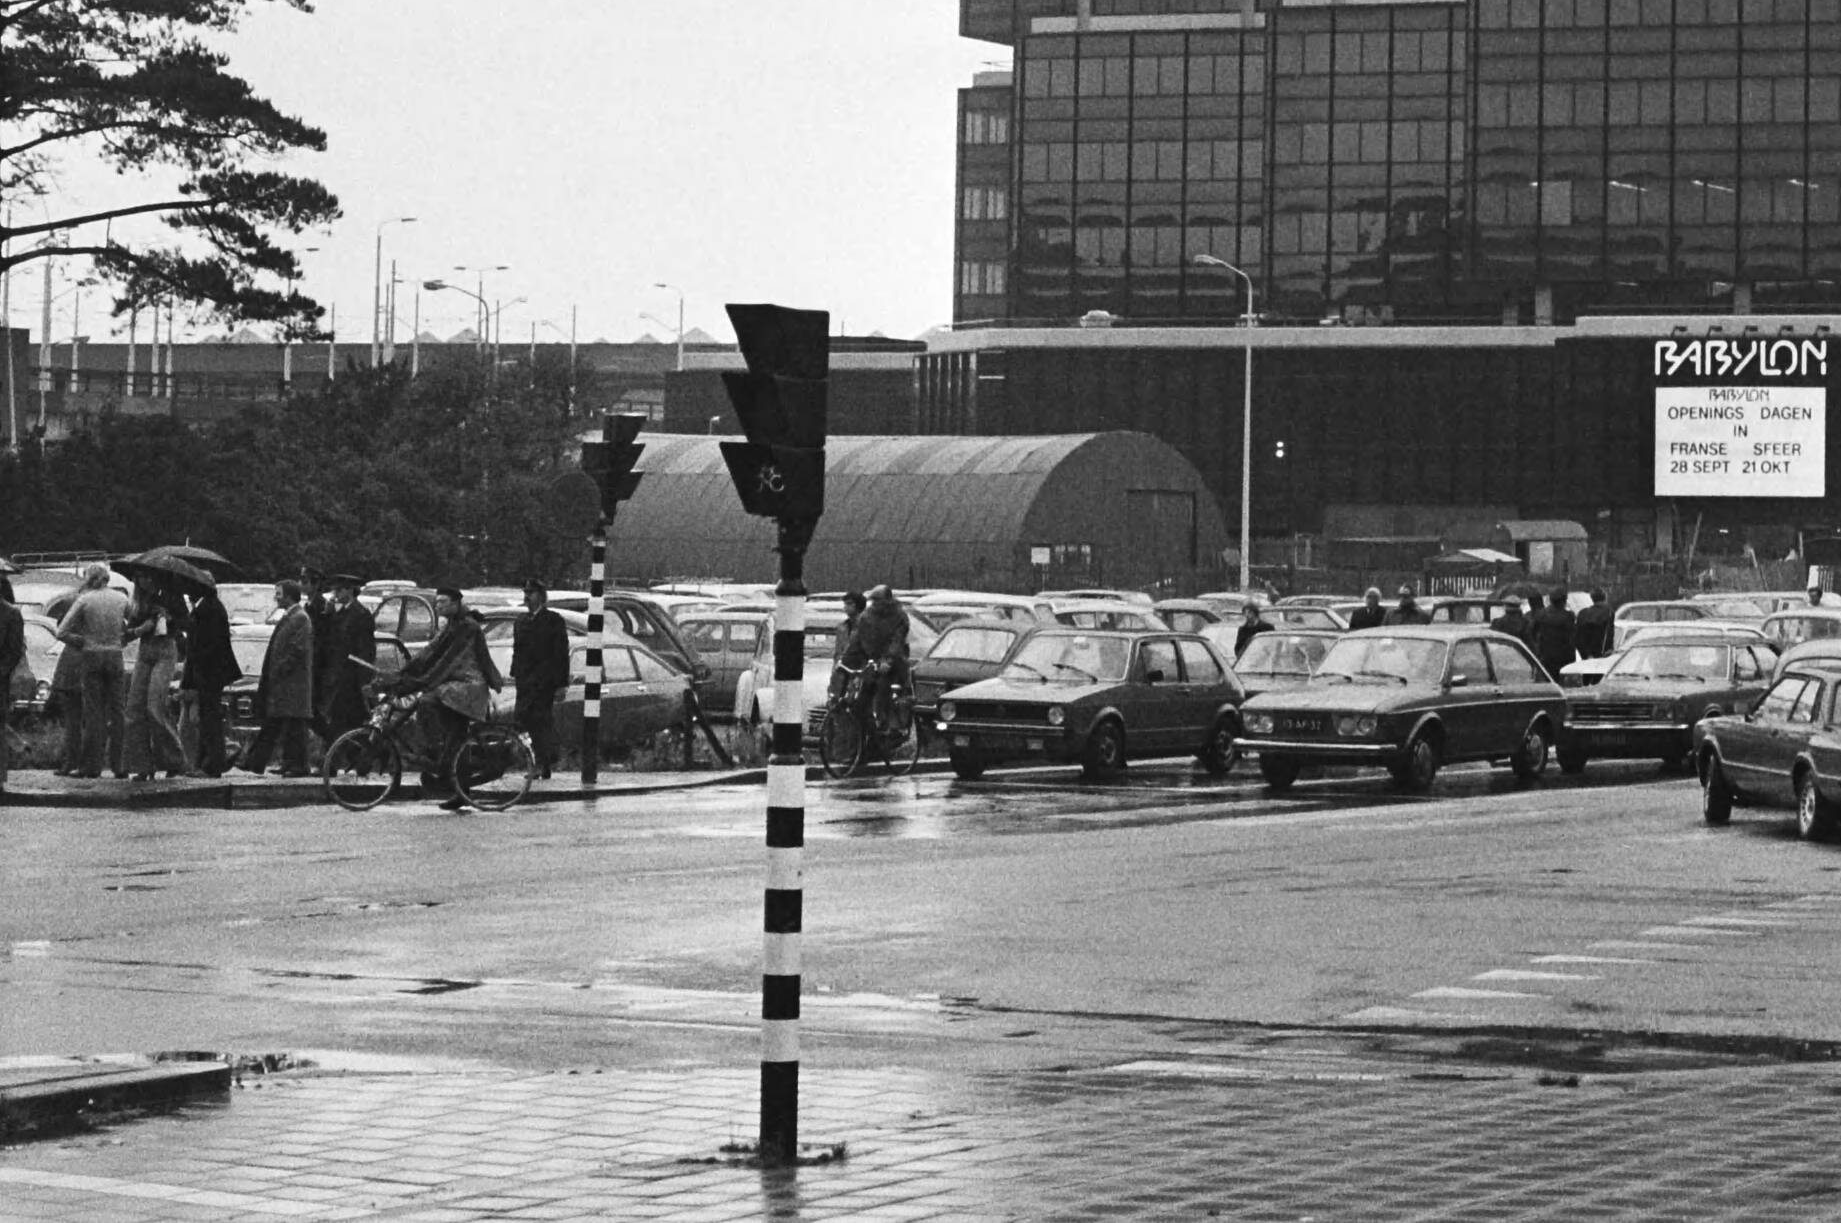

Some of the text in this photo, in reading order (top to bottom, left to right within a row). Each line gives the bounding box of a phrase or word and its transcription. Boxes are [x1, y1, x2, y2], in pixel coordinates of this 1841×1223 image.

[1655, 340, 1827, 376] BABYLON
[1709, 389, 1770, 403] BABYLON
[1667, 407, 1813, 420] OPENINGS DAGEN
[1733, 425, 1748, 438] IN
[1670, 443, 1802, 456] FRANSE SFEER
[1670, 461, 1791, 474] 28 SEPT 21 OKT
